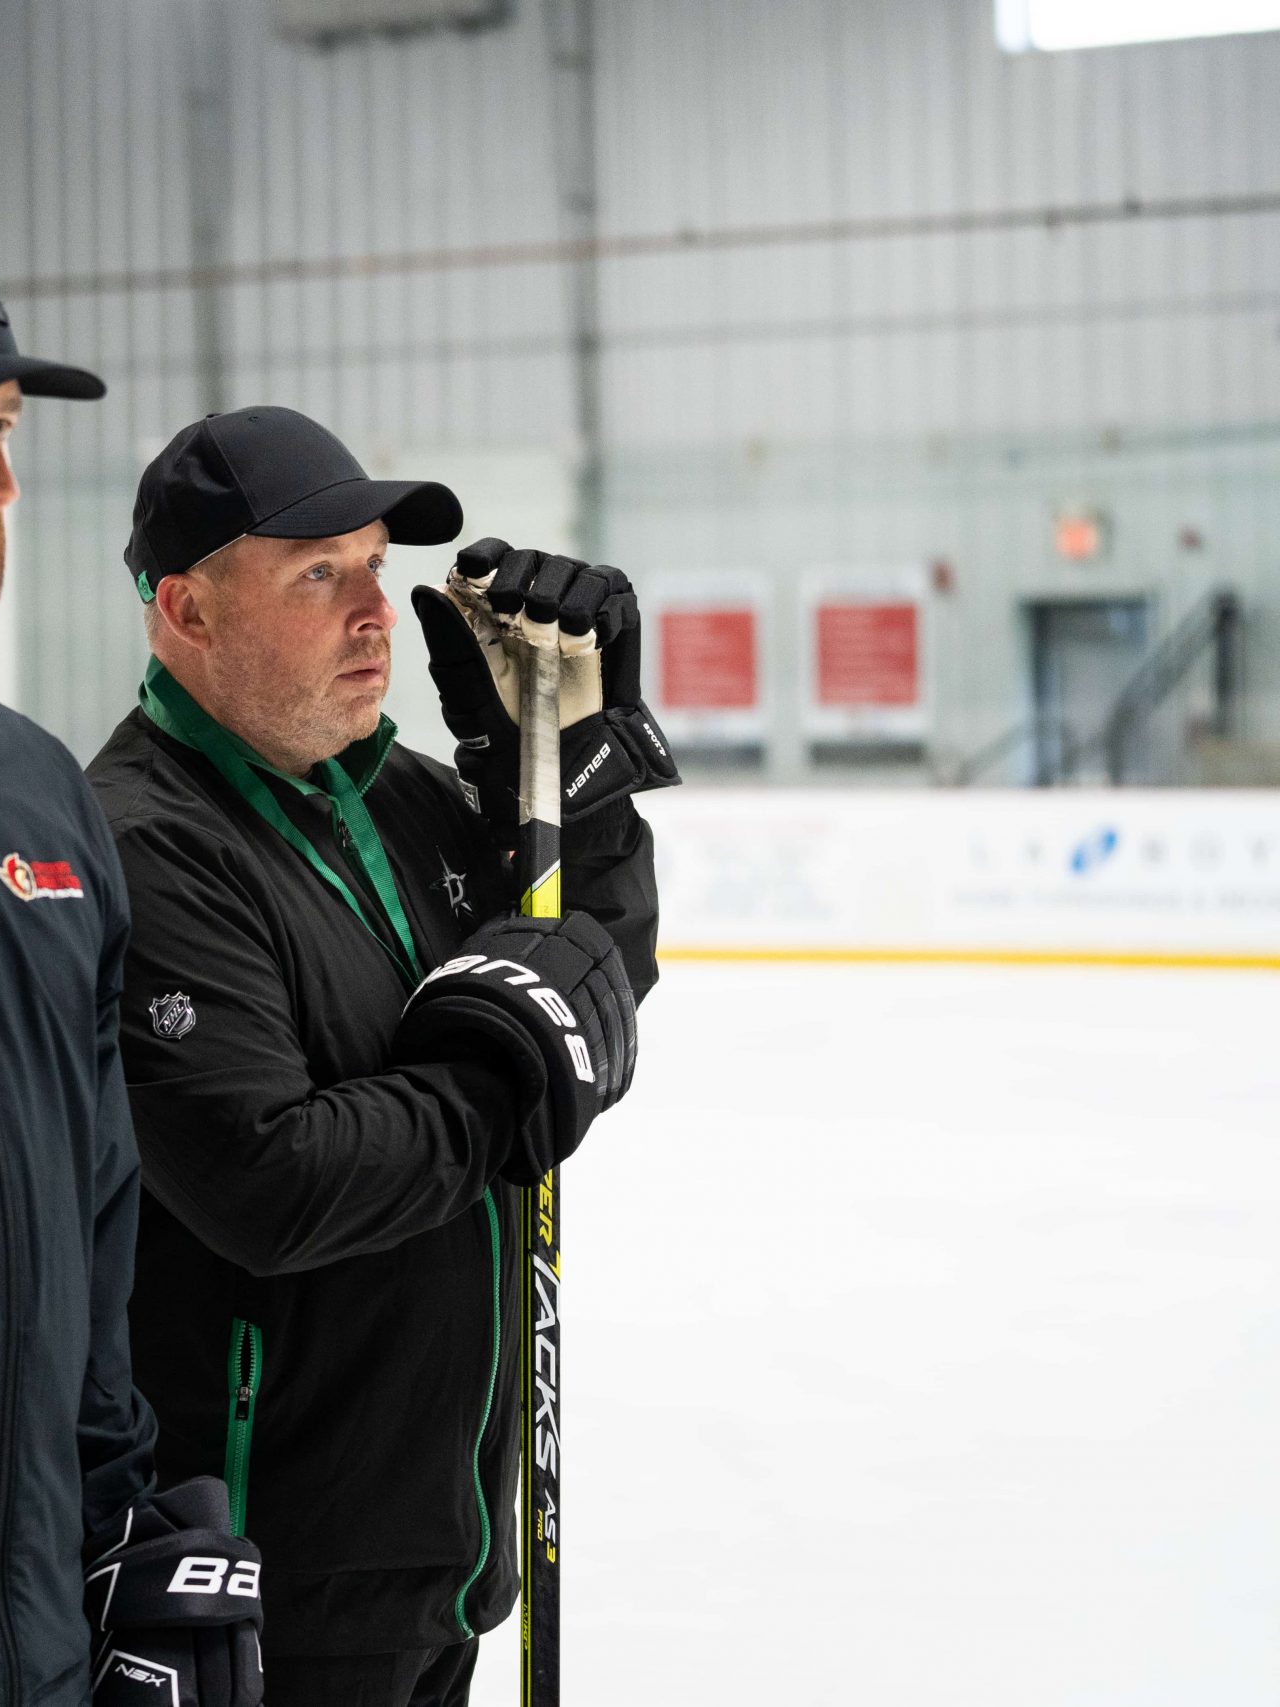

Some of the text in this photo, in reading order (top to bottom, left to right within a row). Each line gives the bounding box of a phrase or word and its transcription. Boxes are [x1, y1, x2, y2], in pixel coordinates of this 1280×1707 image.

[162, 1003, 184, 1032] NHL
[528, 1250, 561, 1480] TACKS
[114, 1663, 167, 1688] NSX
